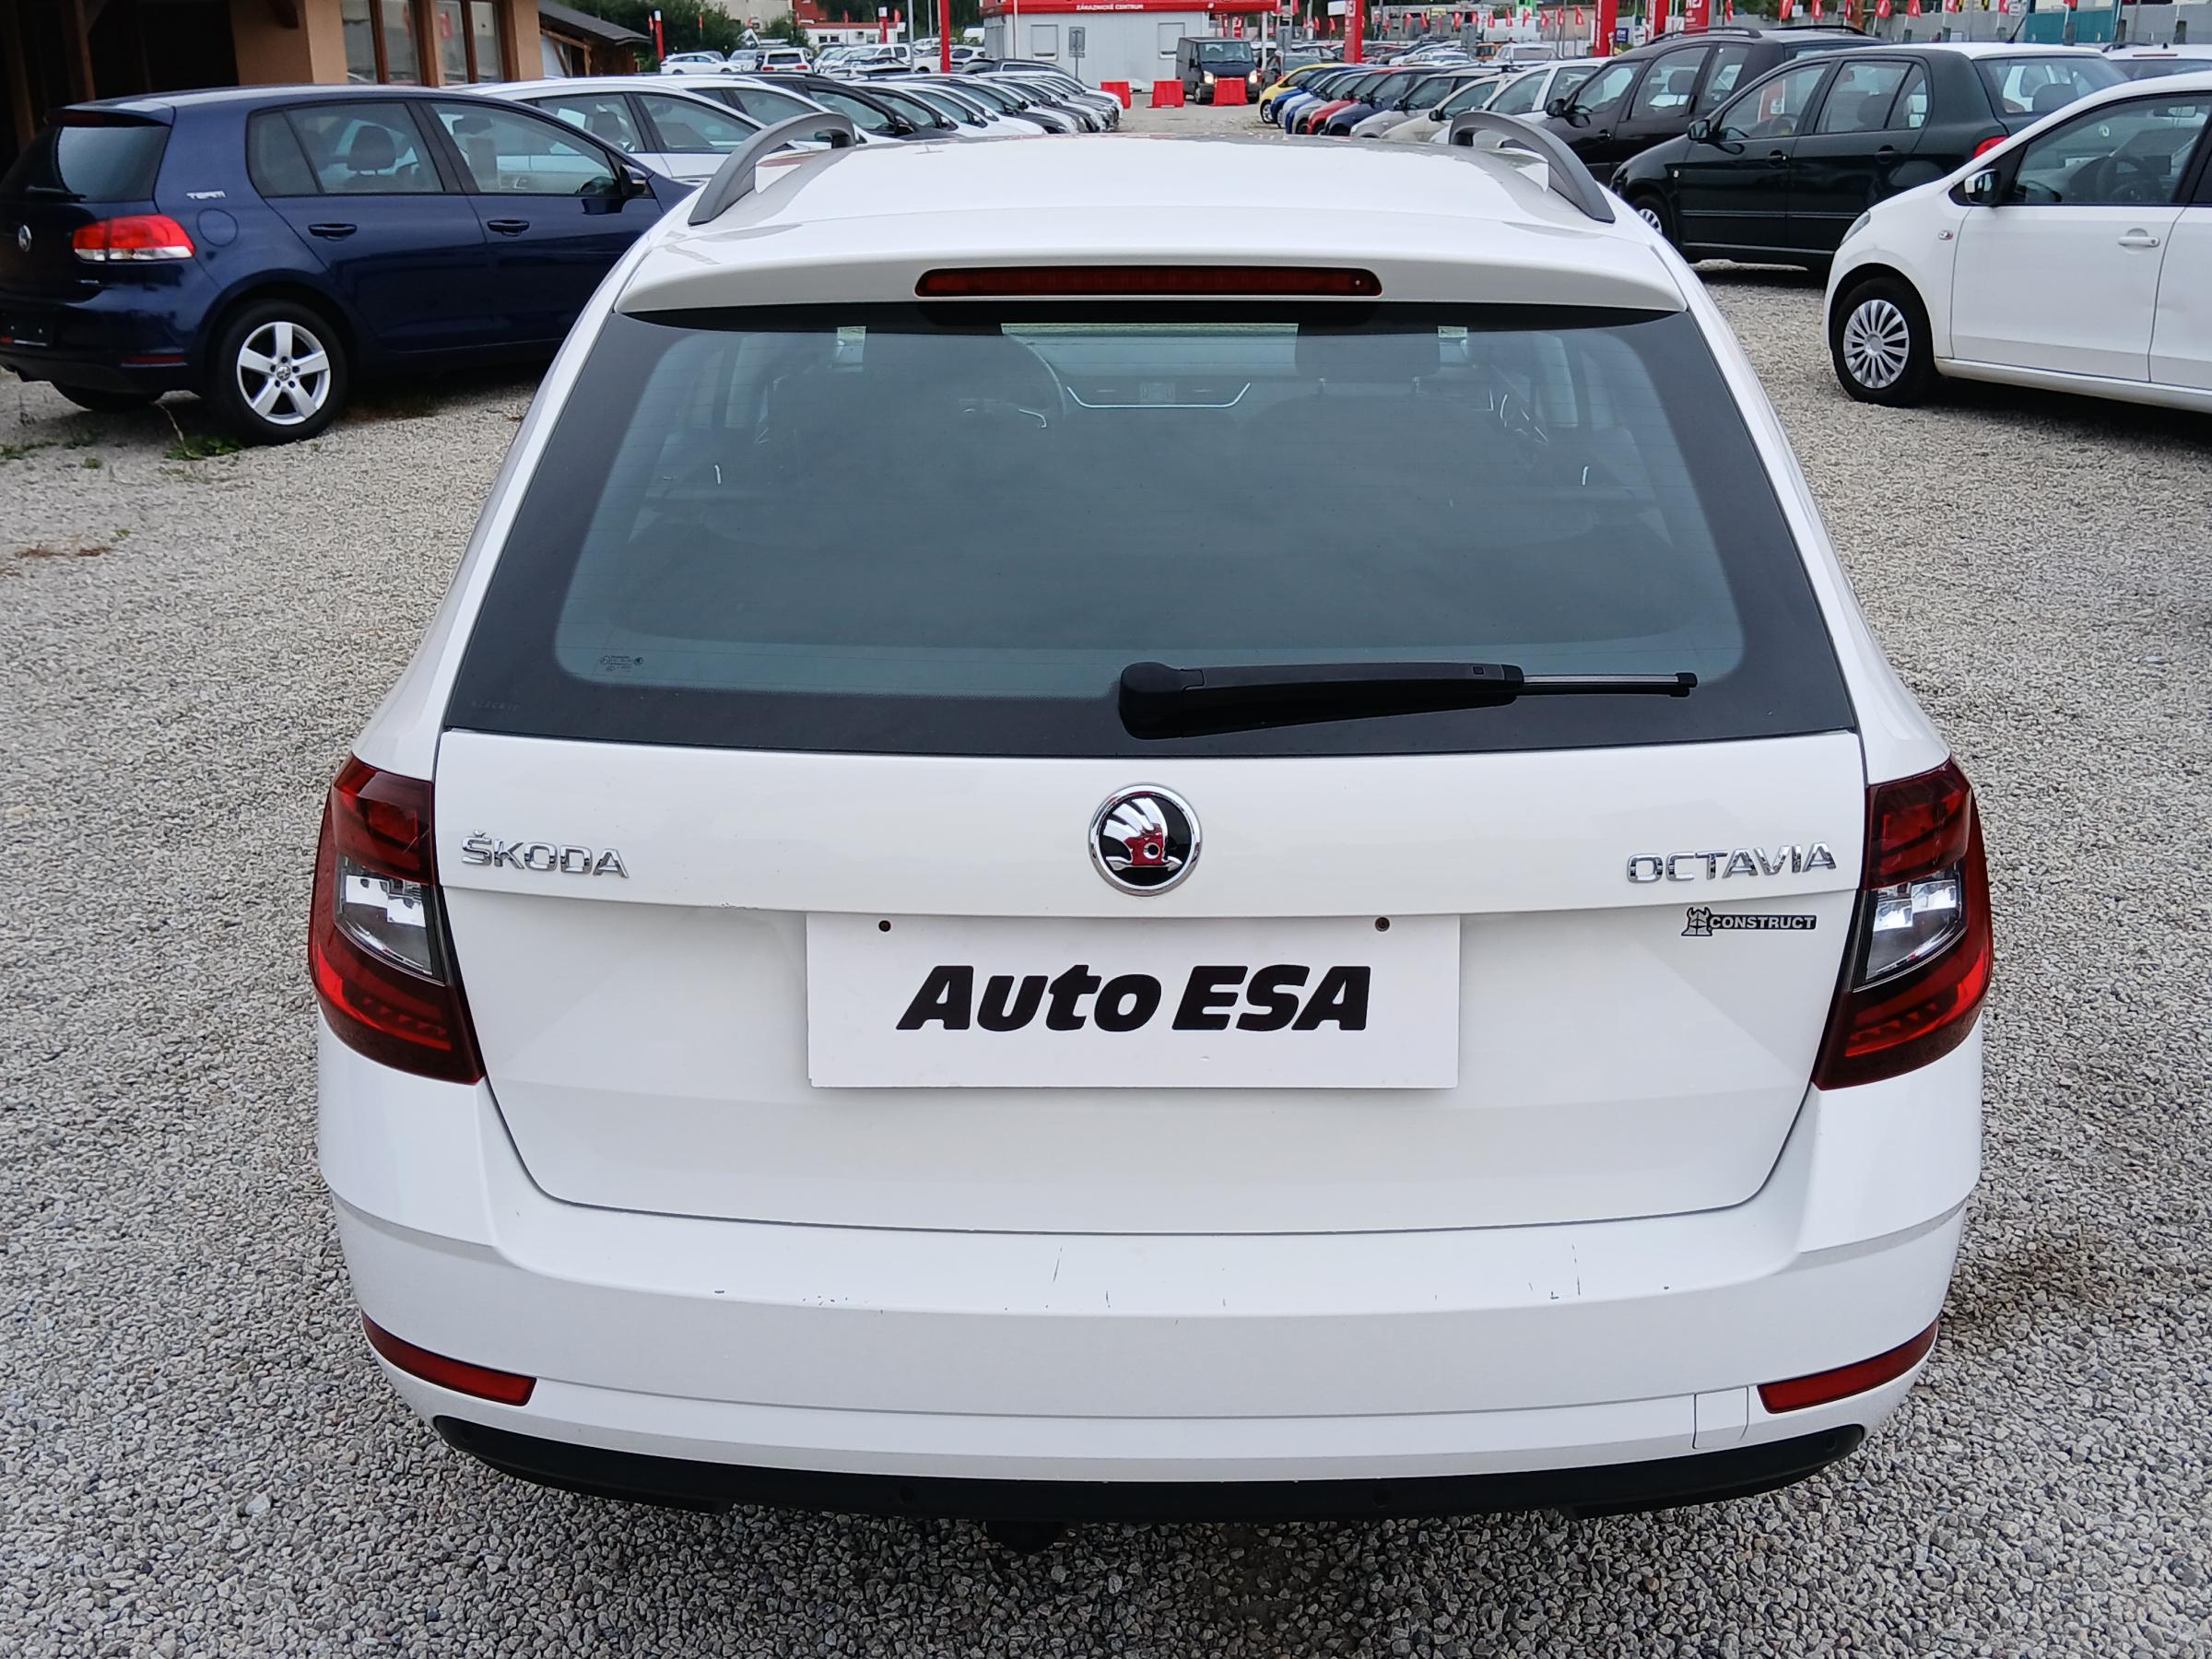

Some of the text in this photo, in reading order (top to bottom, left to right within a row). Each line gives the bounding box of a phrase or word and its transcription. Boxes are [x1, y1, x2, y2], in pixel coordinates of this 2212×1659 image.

[461, 830, 629, 878] ŠKODA
[1627, 841, 1837, 884] OCTAVIA
[1710, 915, 1816, 930] CONSTRUCT
[895, 964, 1371, 1032] Auto ESA
